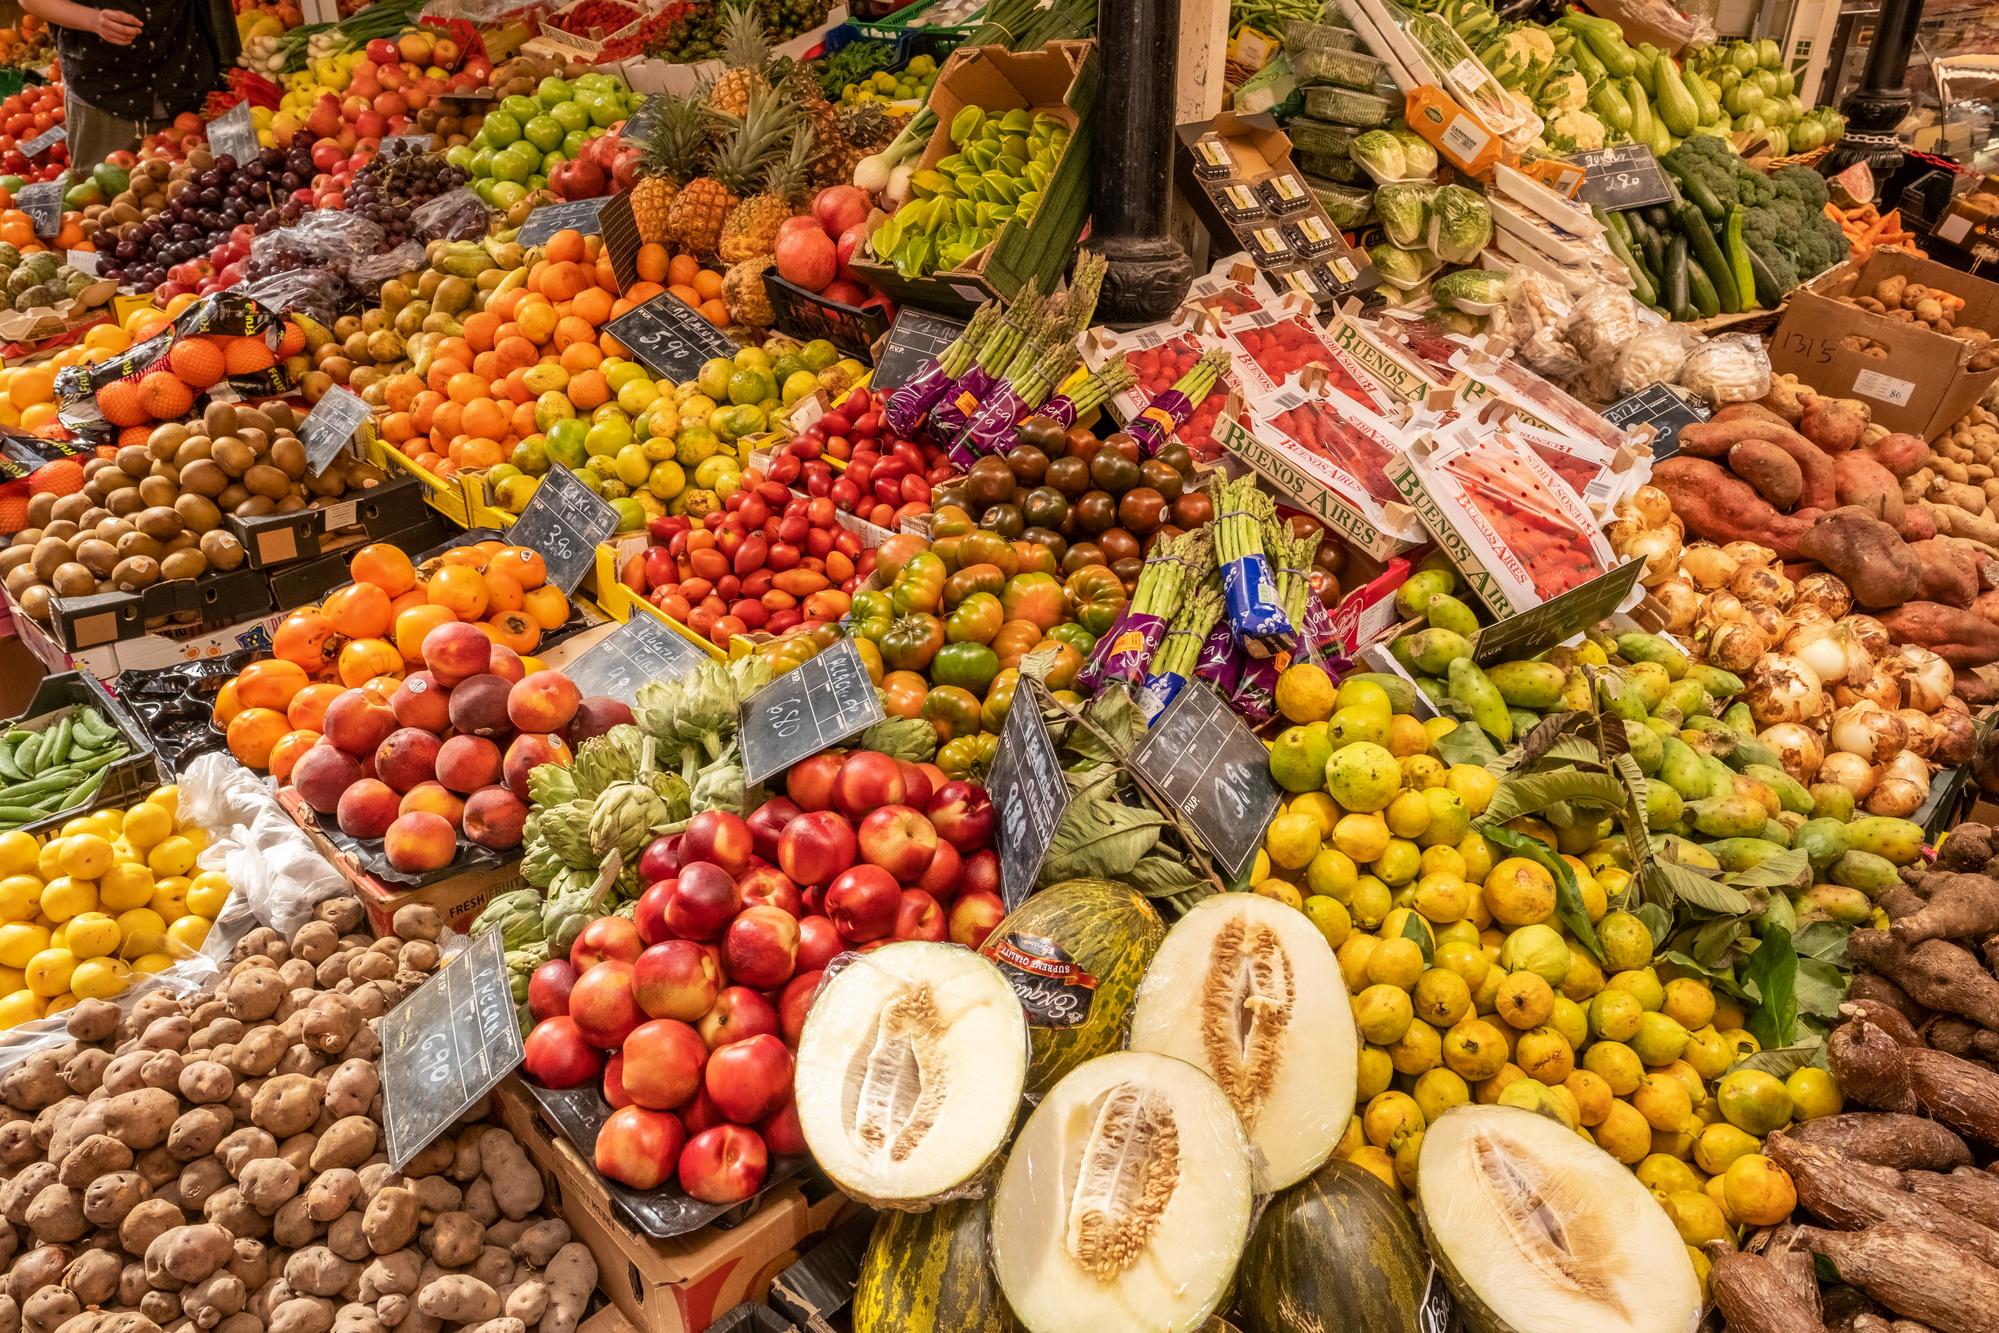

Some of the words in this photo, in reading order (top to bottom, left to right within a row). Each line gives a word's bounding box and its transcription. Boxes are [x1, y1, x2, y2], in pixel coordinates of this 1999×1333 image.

[1335, 322, 1408, 385] BUENOS
[1221, 421, 1306, 494] BUENOS
[1305, 489, 1378, 545] AIRES
[1279, 438, 1328, 475] BUENOS
[1325, 467, 1364, 493] AIRES
[1392, 465, 1471, 563] BUENOS
[1465, 570, 1518, 619] AIR
[1454, 492, 1500, 551] BUENOS
[1491, 544, 1529, 586] AIRES
[1184, 794, 1201, 816] P.V.P.
[448, 893, 486, 919] FRESH
[1000, 945, 1031, 966] QUALITY
[1030, 960, 1070, 974] SUPREME
